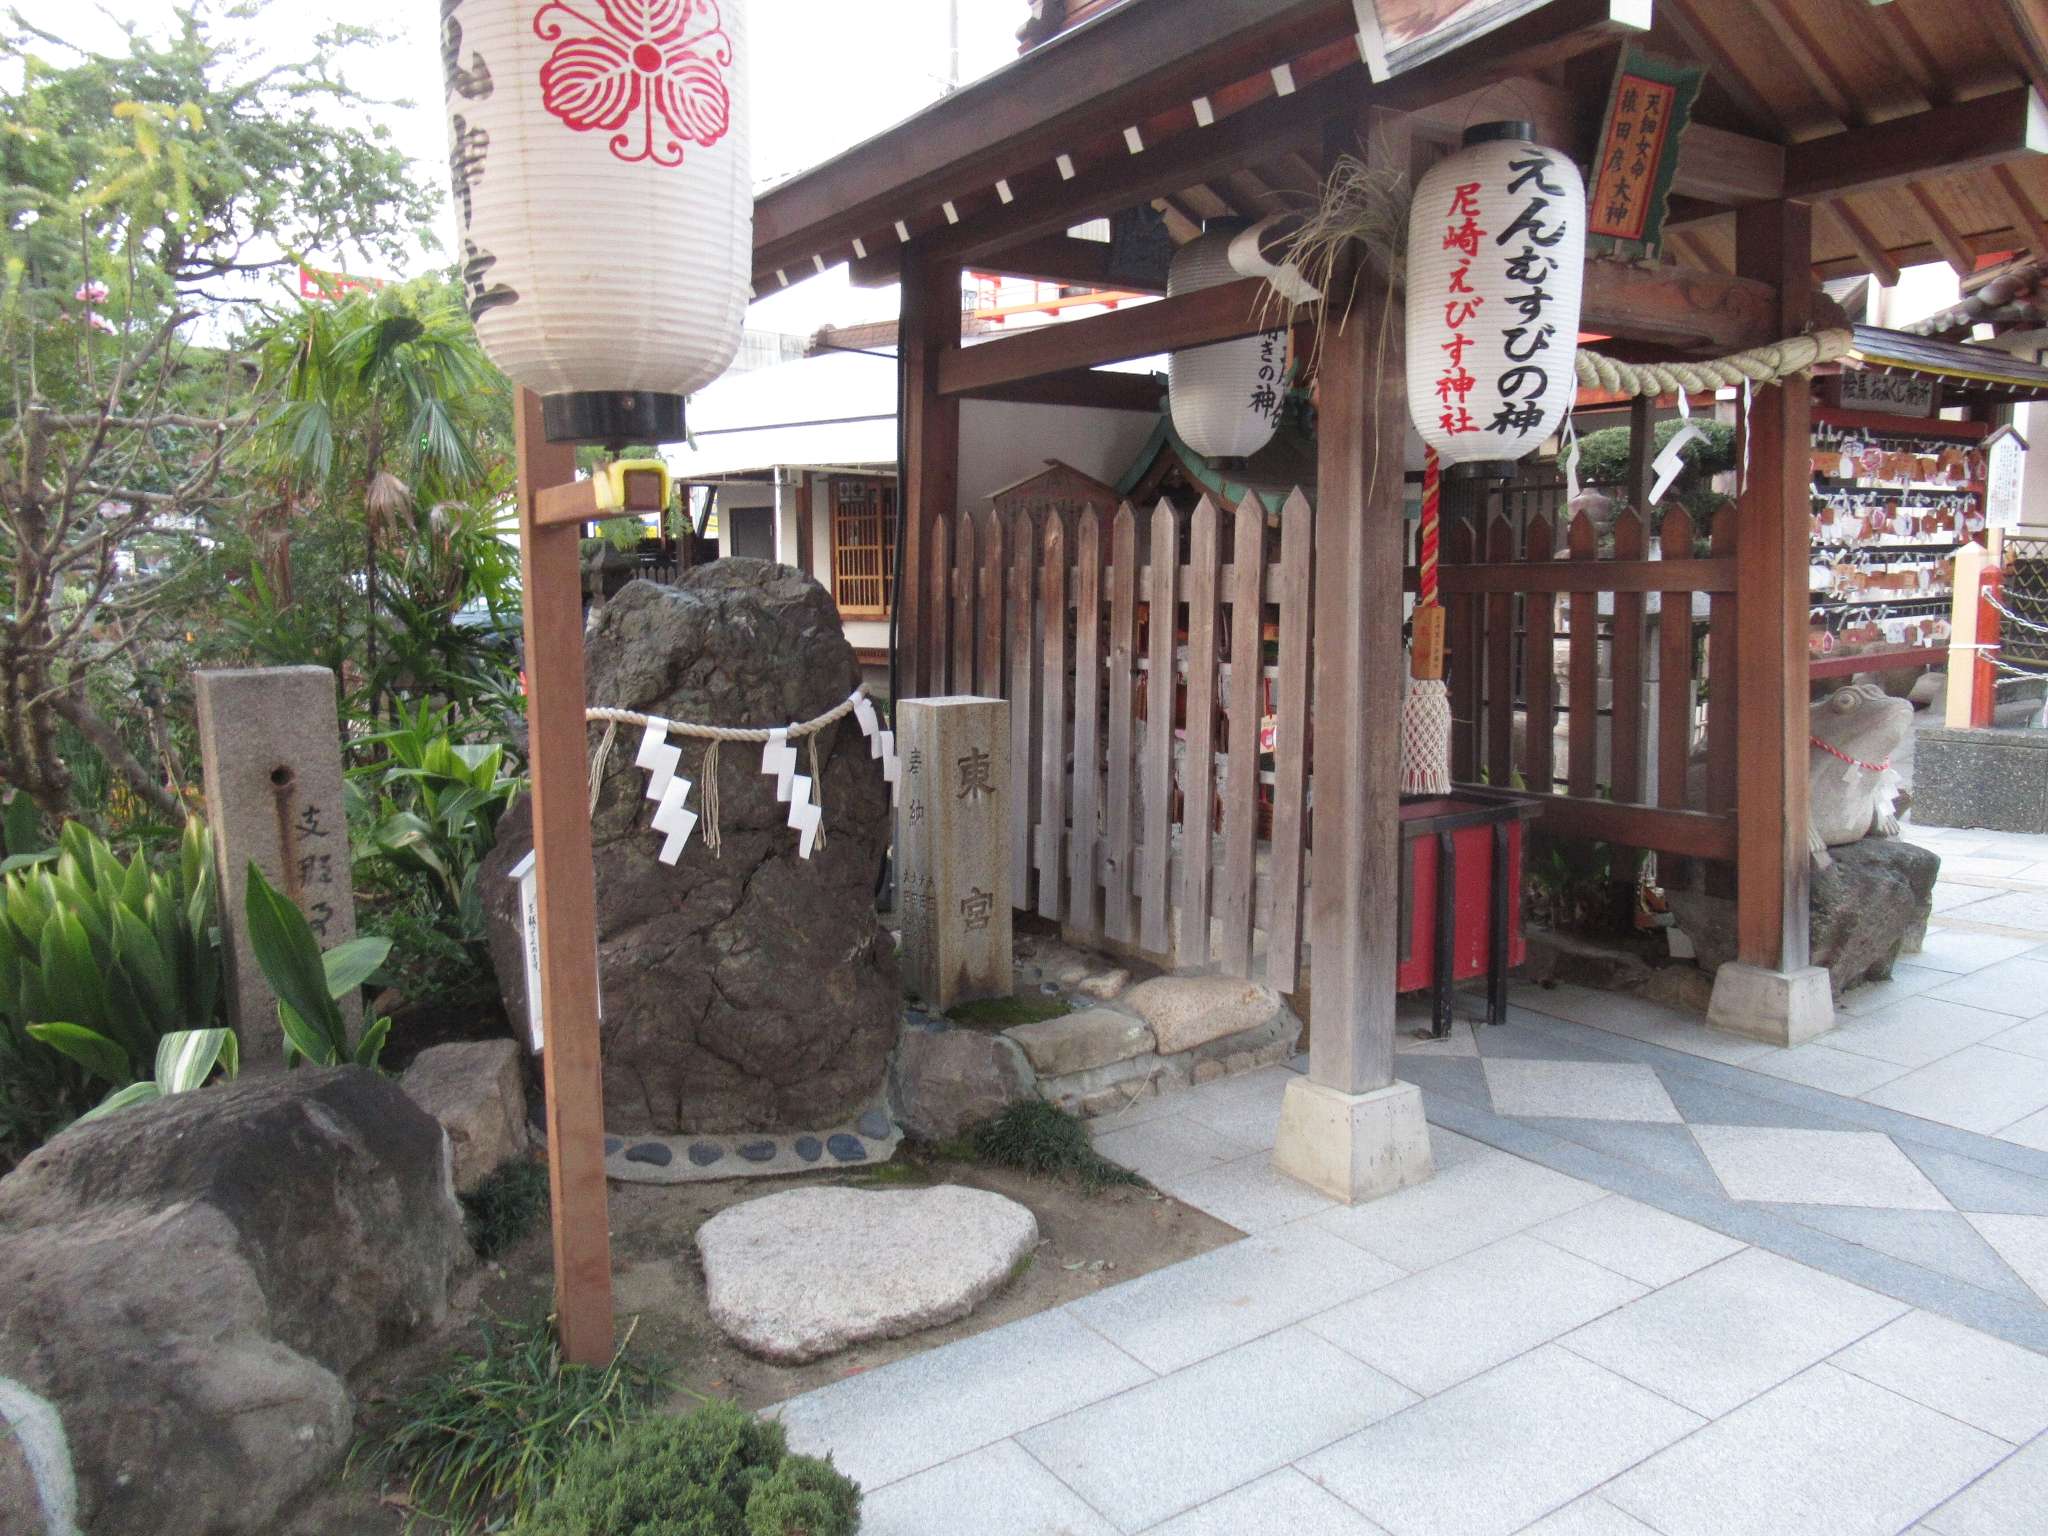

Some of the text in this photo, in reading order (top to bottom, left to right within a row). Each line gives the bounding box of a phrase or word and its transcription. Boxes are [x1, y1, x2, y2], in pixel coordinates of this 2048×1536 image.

[1435, 181, 1488, 436] 尼崎えびす神社
[1484, 148, 1567, 439] えんむすびの神
[955, 747, 997, 934] 東宮
